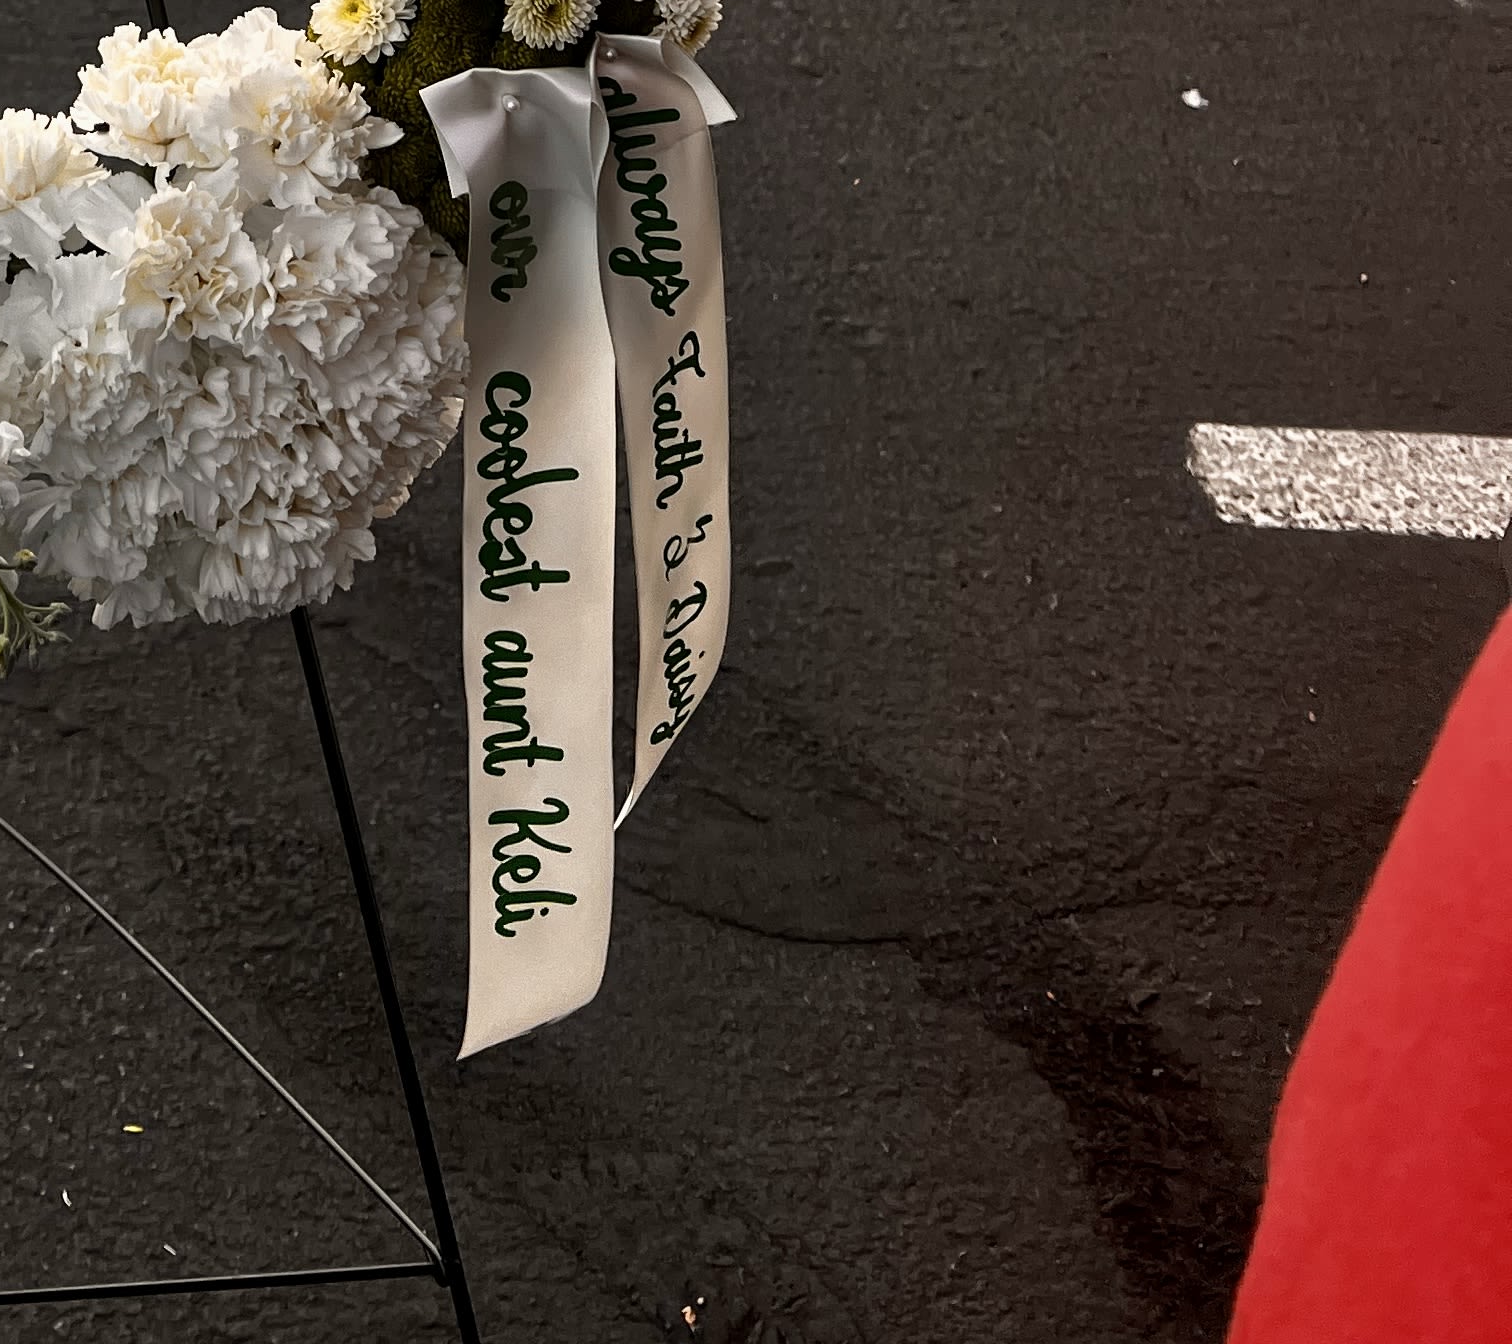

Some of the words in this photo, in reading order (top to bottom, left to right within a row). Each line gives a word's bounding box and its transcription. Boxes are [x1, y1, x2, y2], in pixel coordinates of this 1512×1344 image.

[489, 180, 538, 303] our
[477, 370, 580, 602] coolest
[652, 330, 706, 510] Faith
[481, 630, 565, 776] aunt
[650, 580, 707, 745] Daisy
[488, 797, 578, 938] Keli
